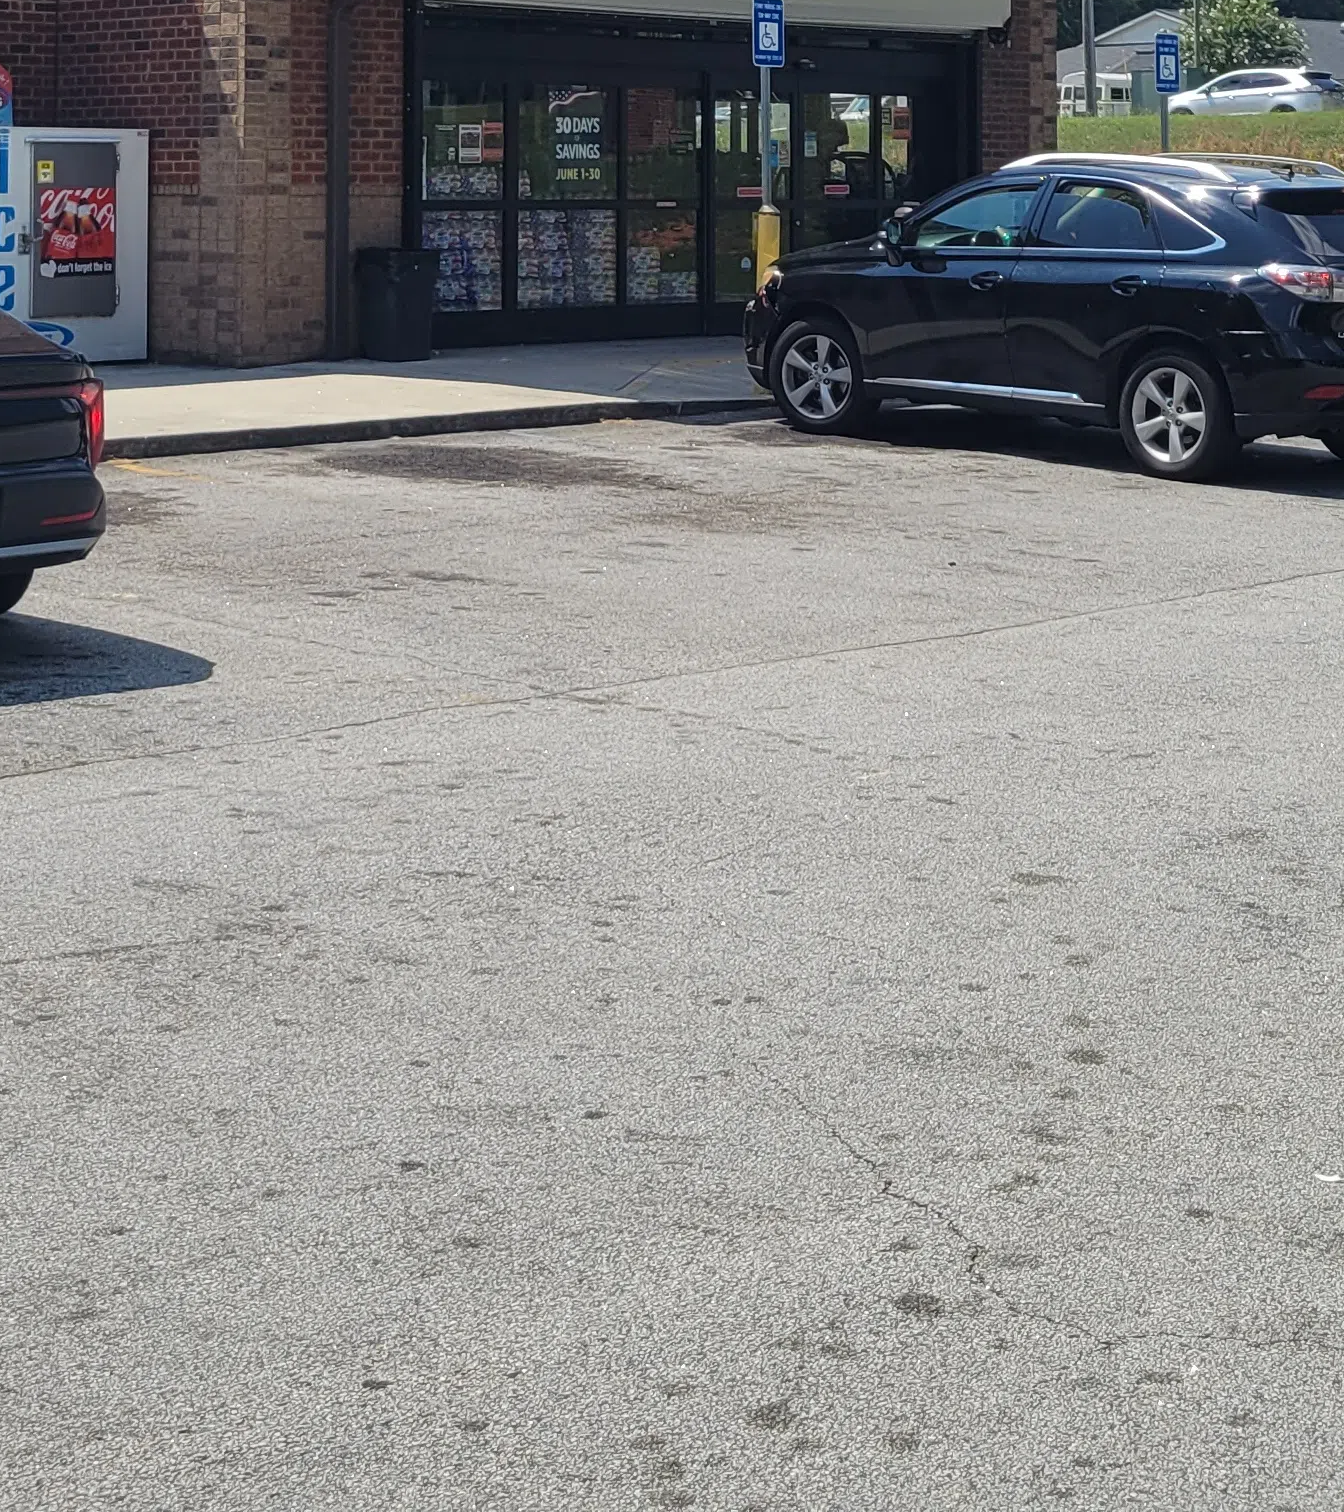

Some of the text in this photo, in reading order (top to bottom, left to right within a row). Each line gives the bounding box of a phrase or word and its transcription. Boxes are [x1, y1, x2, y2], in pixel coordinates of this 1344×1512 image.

[556, 117, 600, 134] 30 DAYS
[556, 144, 600, 159] SAVINGS
[556, 168, 601, 180] JUNE 1-30
[75, 262, 92, 274] forget
[93, 261, 103, 272] the
[104, 261, 112, 271] ice
